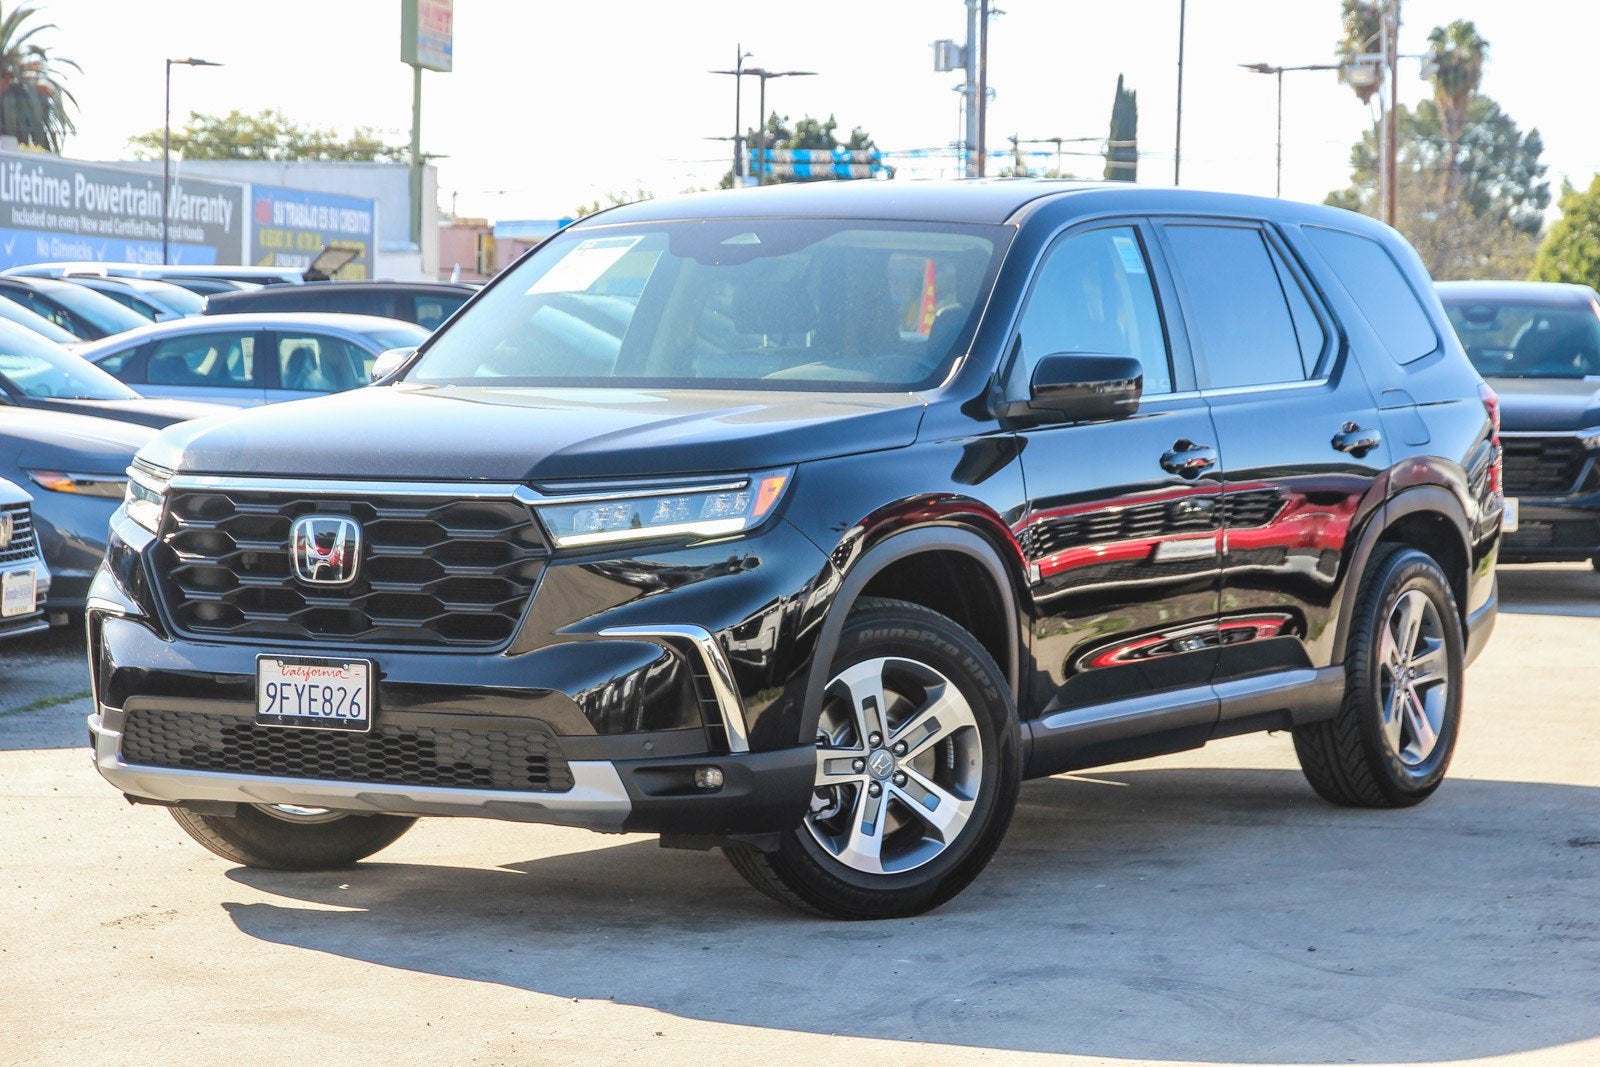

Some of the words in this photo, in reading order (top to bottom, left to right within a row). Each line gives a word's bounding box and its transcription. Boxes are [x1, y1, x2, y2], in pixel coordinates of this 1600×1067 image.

[1, 162, 70, 208] Lifetime
[75, 172, 163, 217] Powertrain
[167, 183, 233, 233] Warranty
[12, 206, 45, 227] Included
[46, 213, 57, 228] on
[58, 214, 79, 232] every
[80, 214, 98, 233] New
[99, 216, 112, 234] and
[281, 666, 349, 681] California
[265, 682, 362, 718] 9FYE826
